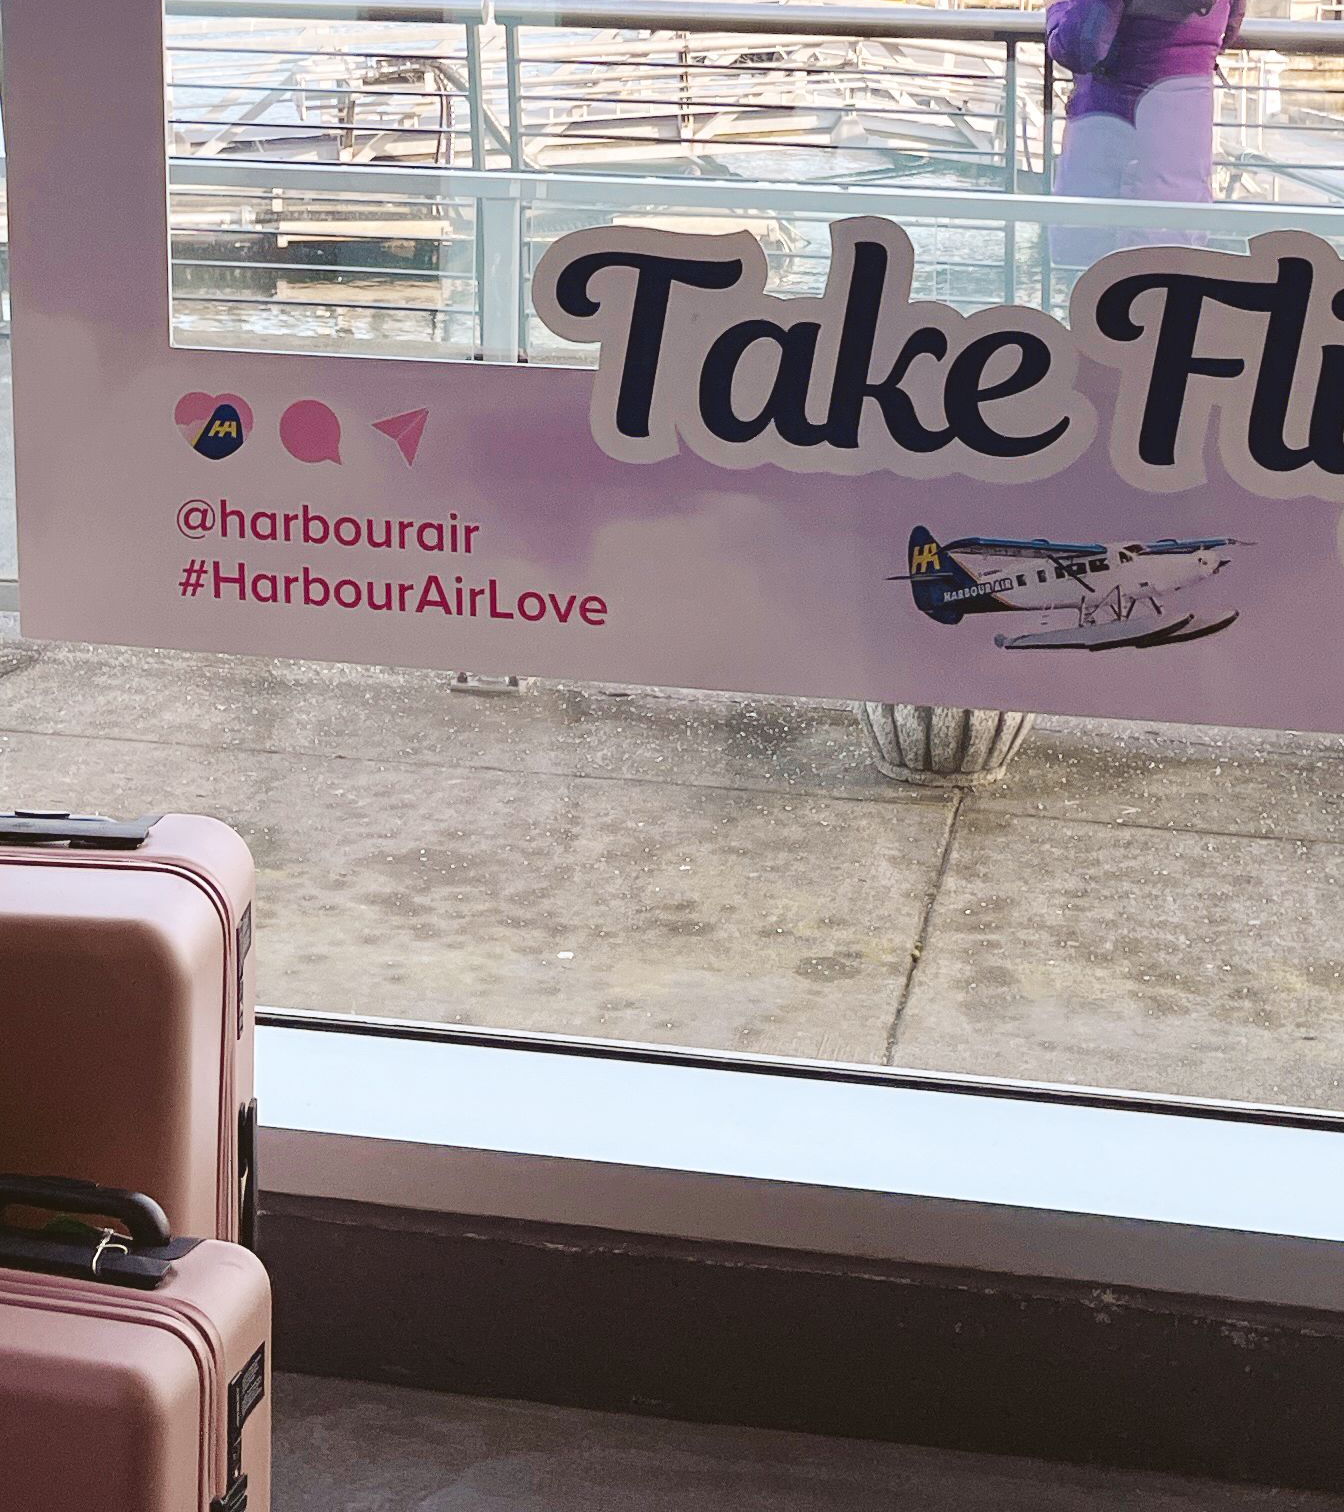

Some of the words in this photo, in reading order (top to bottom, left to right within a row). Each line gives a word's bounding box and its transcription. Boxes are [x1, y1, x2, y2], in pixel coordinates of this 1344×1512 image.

[554, 240, 1070, 458] Take
[176, 499, 480, 555] @harbourair
[178, 559, 608, 627] #HarbourAirLove
[943, 582, 991, 603] HARBOUR
[990, 578, 1014, 593] AIR
